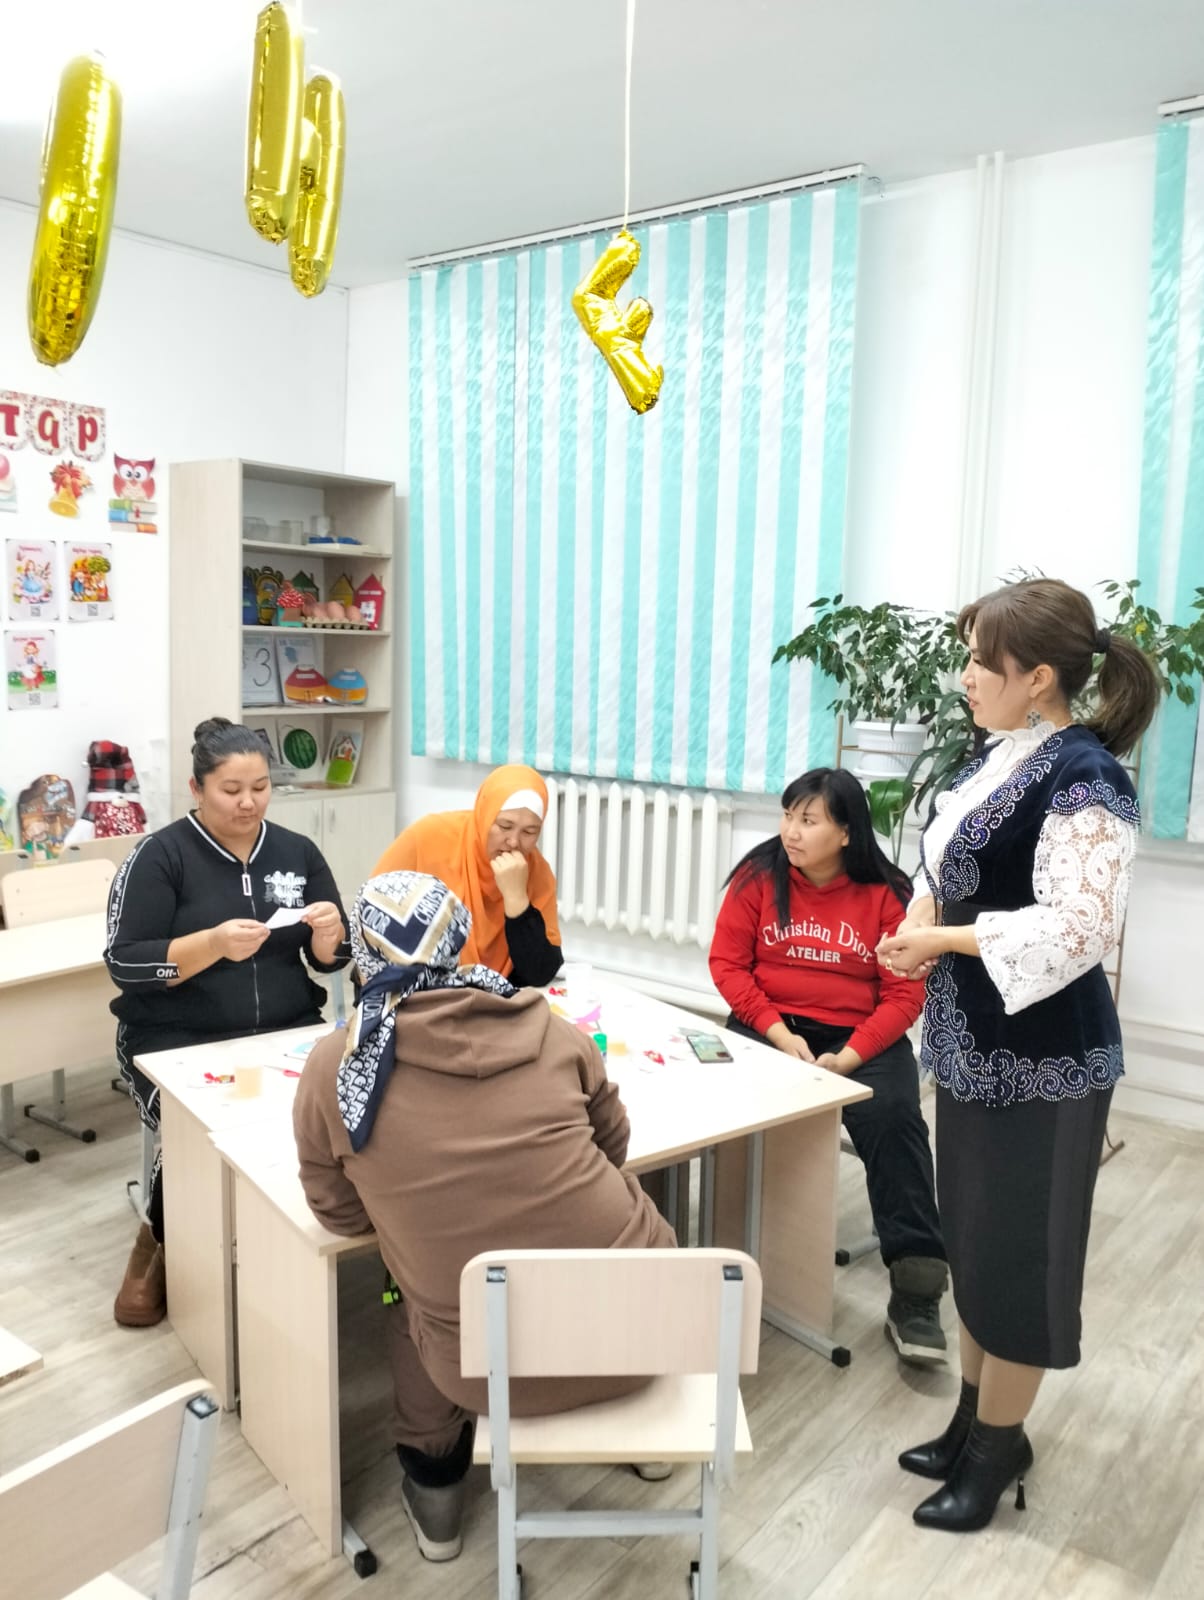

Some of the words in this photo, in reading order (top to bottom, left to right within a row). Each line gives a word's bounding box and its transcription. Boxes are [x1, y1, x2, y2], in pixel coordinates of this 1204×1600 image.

[762, 916, 832, 946] Christian
[837, 921, 873, 964] Dior
[786, 945, 841, 964] ATELIER
[156, 967, 179, 980] Off-
